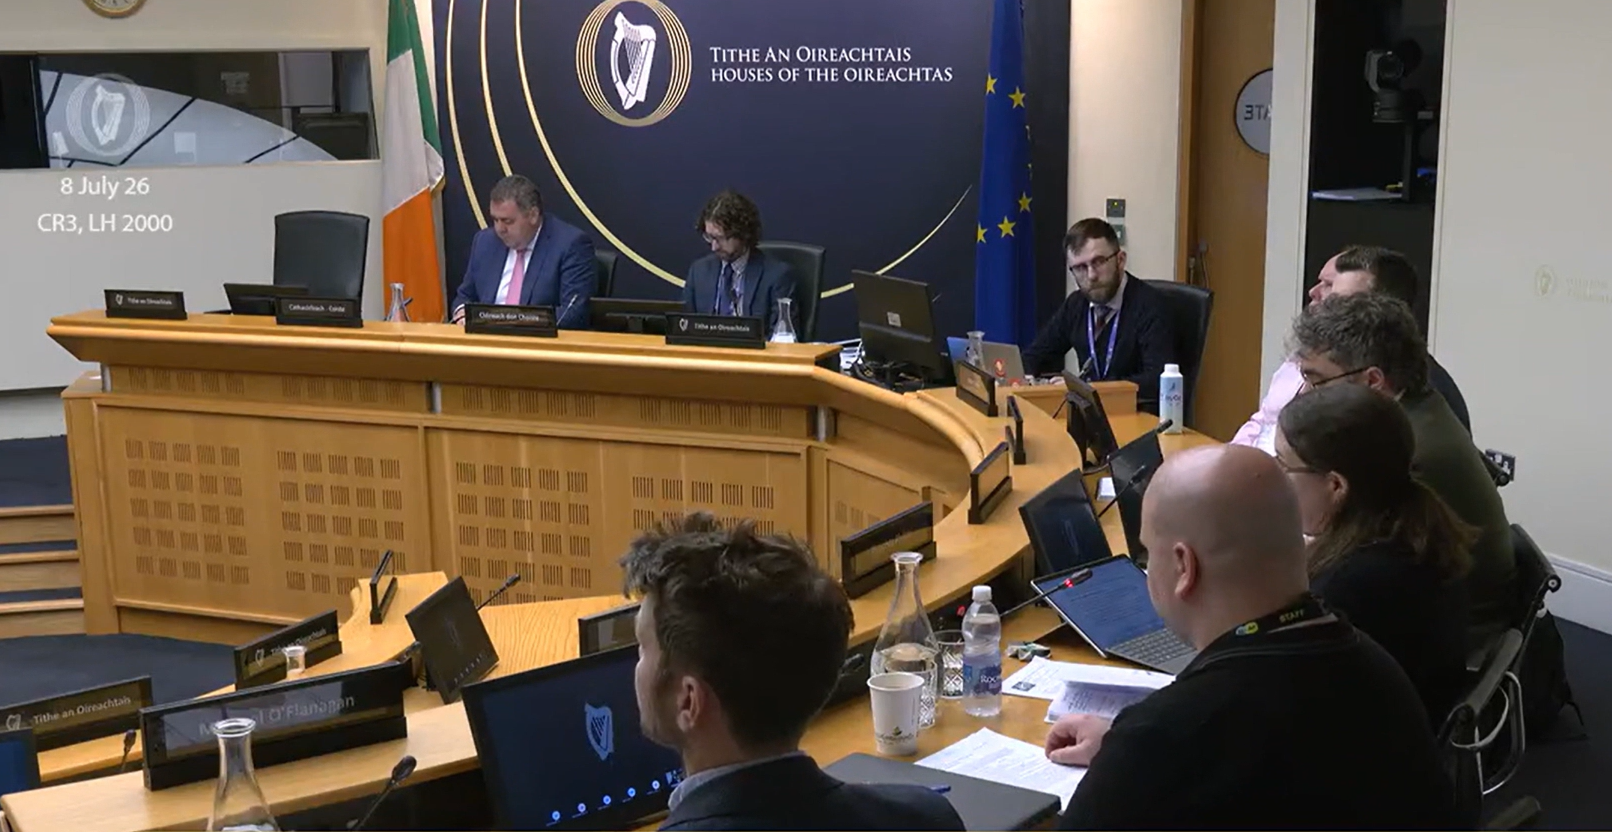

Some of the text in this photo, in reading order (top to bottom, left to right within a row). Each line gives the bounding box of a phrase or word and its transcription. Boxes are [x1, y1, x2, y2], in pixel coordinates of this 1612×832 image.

[709, 45, 912, 62] TITHE AN OIREACHTAIS
[711, 67, 953, 82] HOUSES OF THE OIREACHTAS
[33, 696, 131, 725] Tithe an Oireachtais
[269, 696, 355, 721] O'Flanagan
